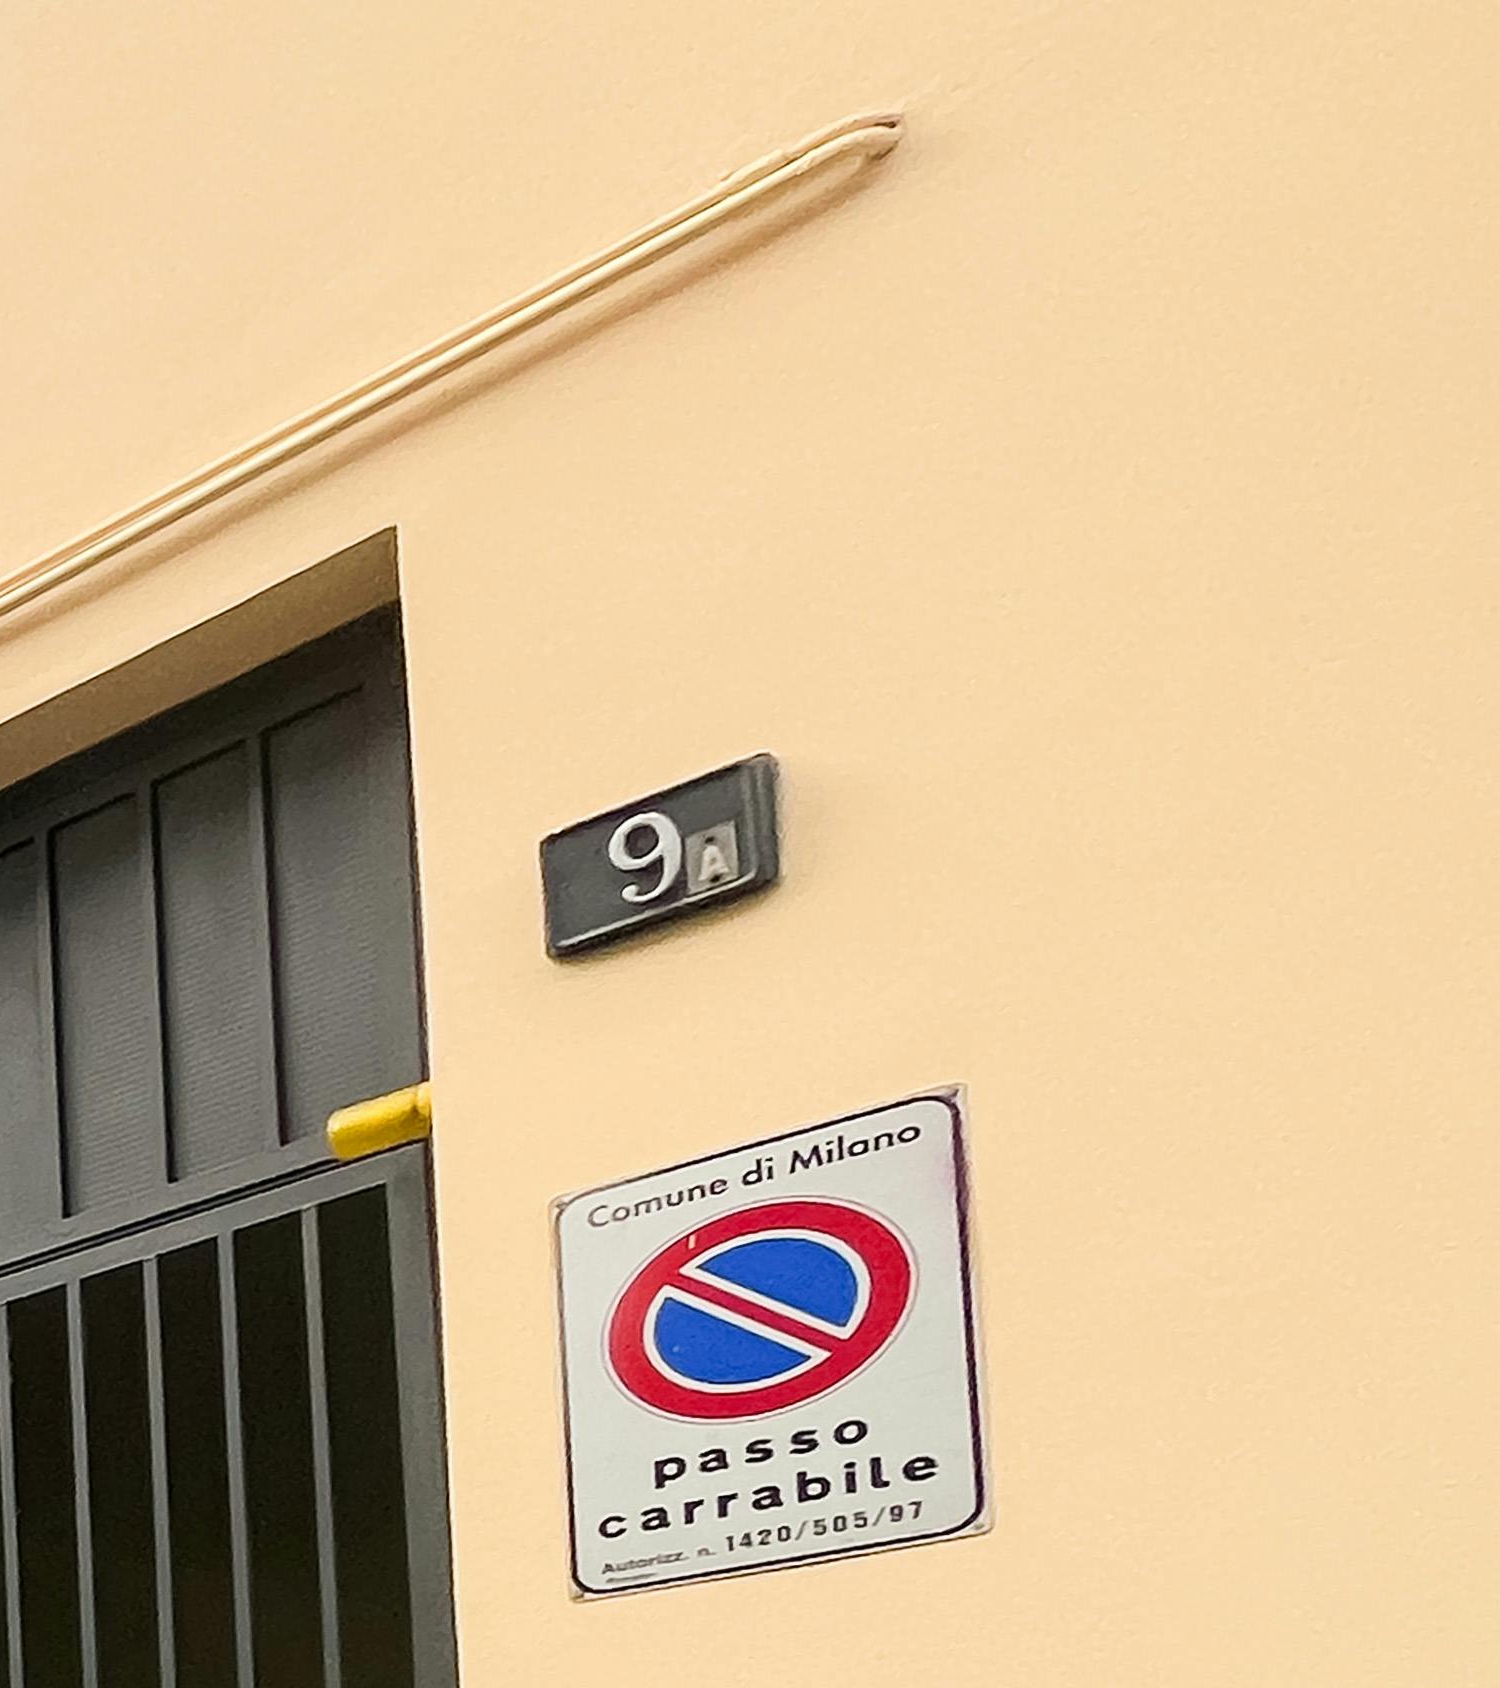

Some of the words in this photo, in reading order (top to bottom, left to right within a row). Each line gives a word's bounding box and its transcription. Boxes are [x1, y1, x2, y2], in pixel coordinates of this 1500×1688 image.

[588, 1178, 728, 1228] Comune
[742, 1156, 774, 1187] di
[789, 1125, 921, 1174] Milano
[653, 1419, 869, 1490] passo
[598, 1455, 939, 1539] carrabile
[726, 1501, 923, 1552] 1420/505/97
